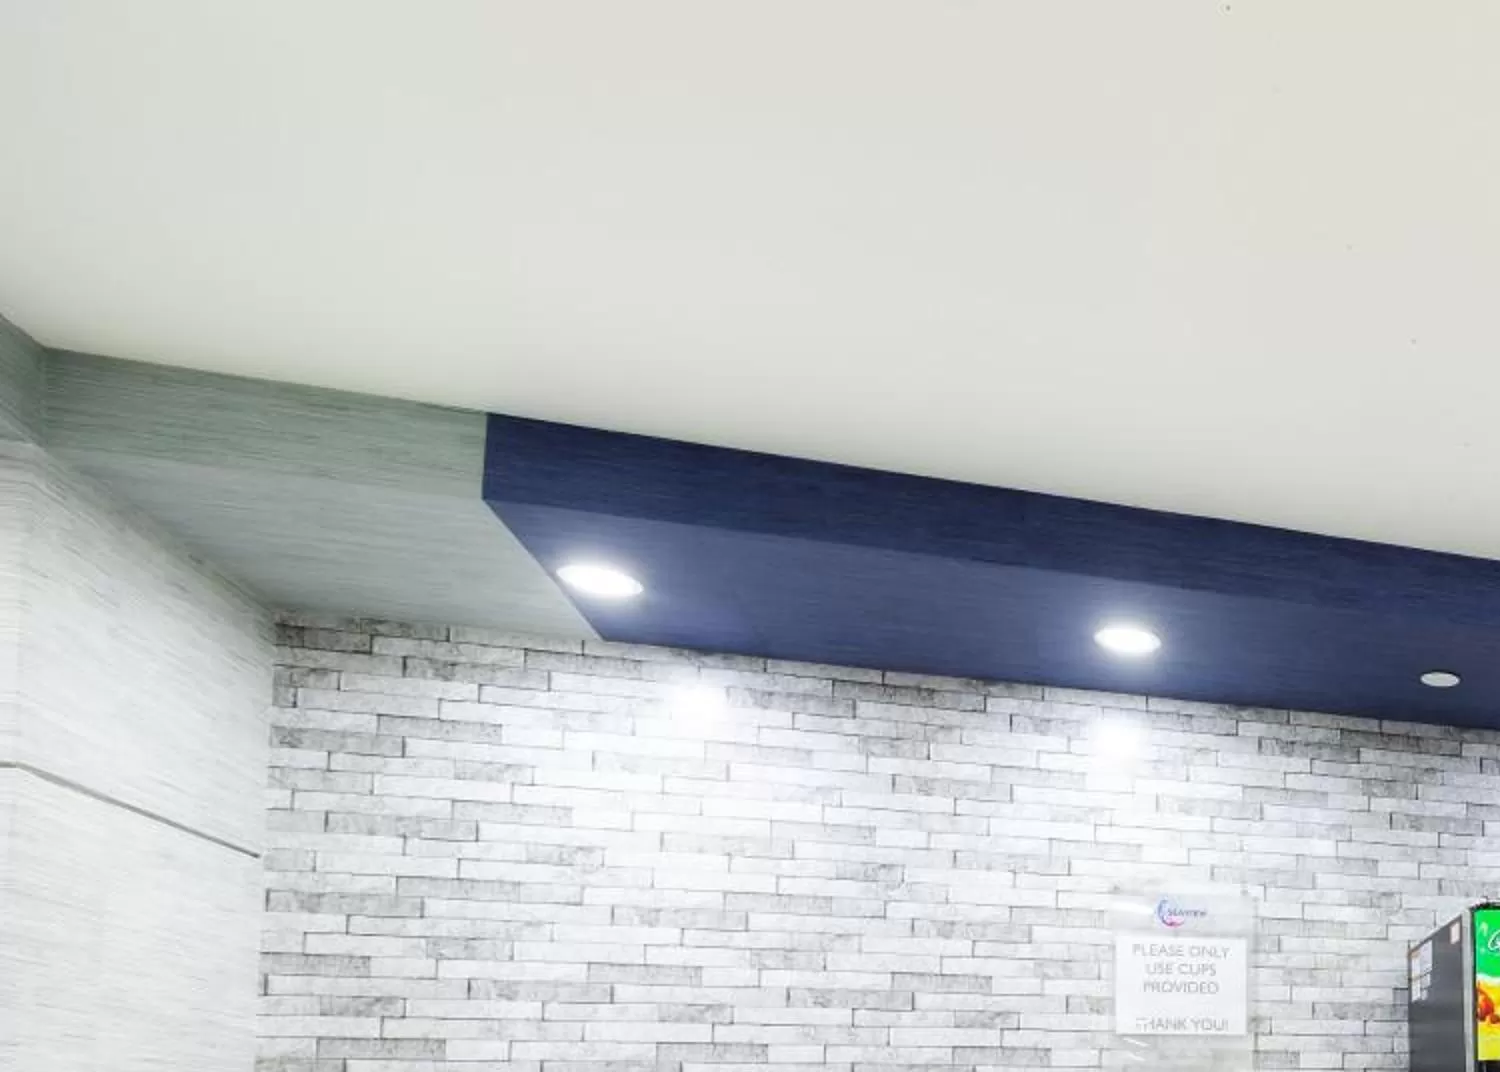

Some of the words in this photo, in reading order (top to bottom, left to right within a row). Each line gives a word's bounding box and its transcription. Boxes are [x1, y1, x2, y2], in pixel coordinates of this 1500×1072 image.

[1132, 943, 1185, 957] PLEASE
[1190, 946, 1231, 960] ONLY
[1145, 963, 1173, 975] USE
[1177, 963, 1217, 977] CUPS
[1143, 980, 1220, 995] PROVIDED
[1136, 1017, 1185, 1031] THANK
[1190, 1017, 1229, 1032] YOU!
